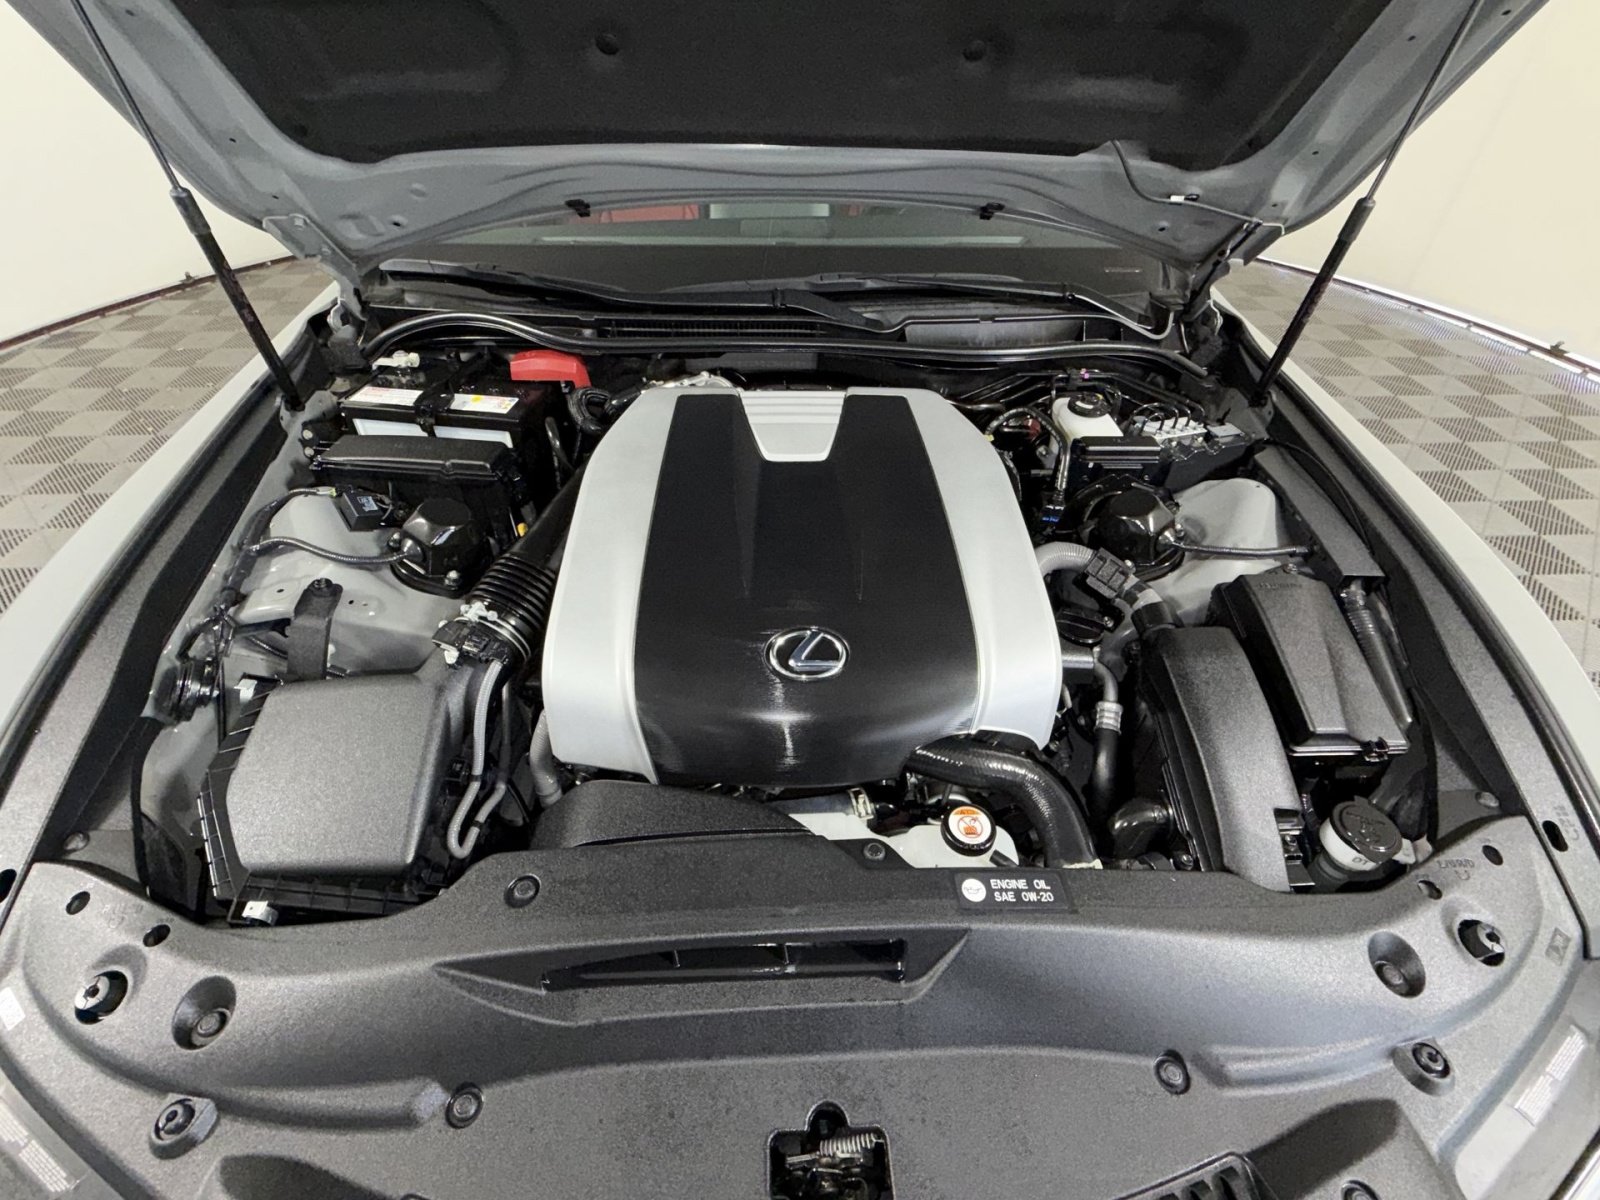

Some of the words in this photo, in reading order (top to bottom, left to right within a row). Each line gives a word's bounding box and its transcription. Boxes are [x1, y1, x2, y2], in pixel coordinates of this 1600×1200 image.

[990, 879, 1028, 889] ENGINE
[1033, 879, 1051, 889] OIL
[994, 891, 1016, 901] SAE
